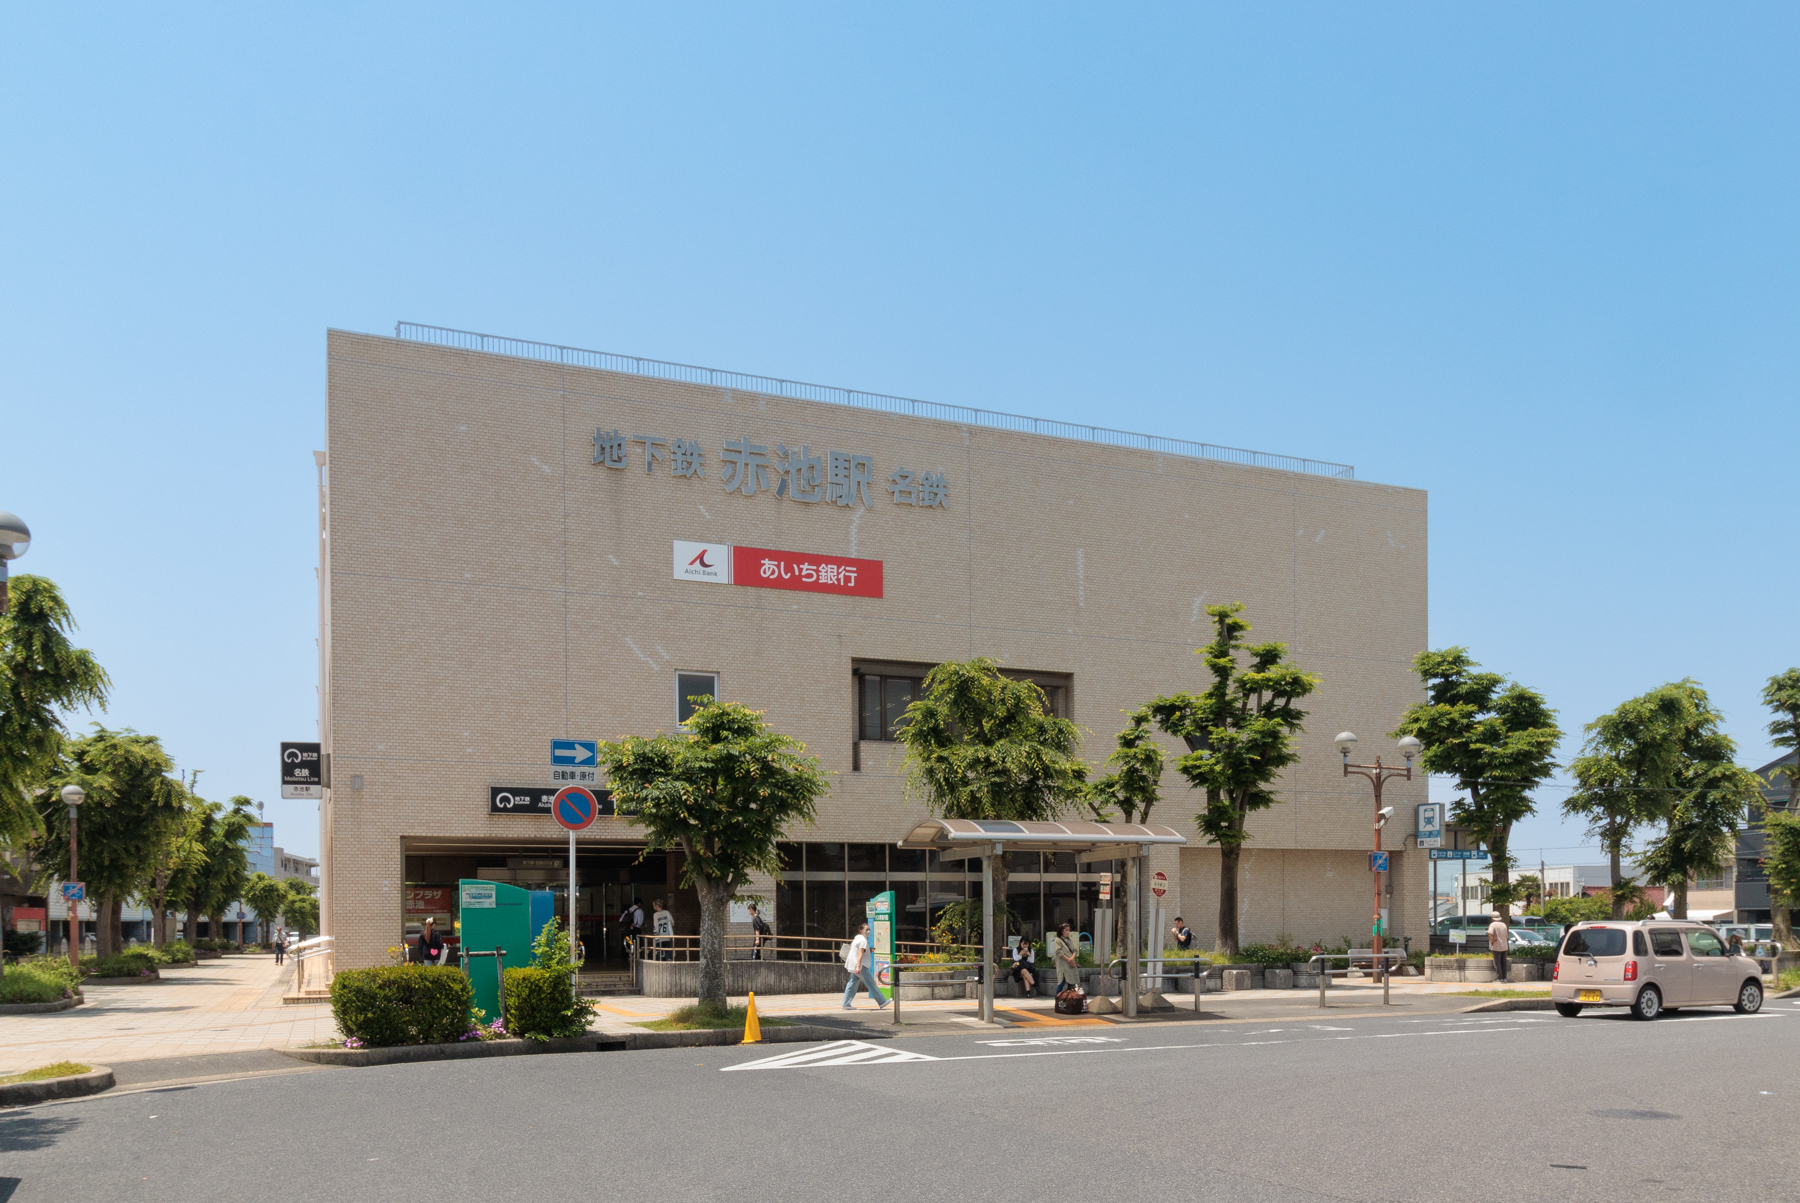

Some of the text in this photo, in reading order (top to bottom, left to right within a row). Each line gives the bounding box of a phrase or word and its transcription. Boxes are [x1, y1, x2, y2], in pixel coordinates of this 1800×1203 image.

[592, 428, 951, 509] 地下鉄 赤池駅 名鉄
[759, 558, 858, 587] あいち銀行
[294, 768, 310, 776] 名鉄
